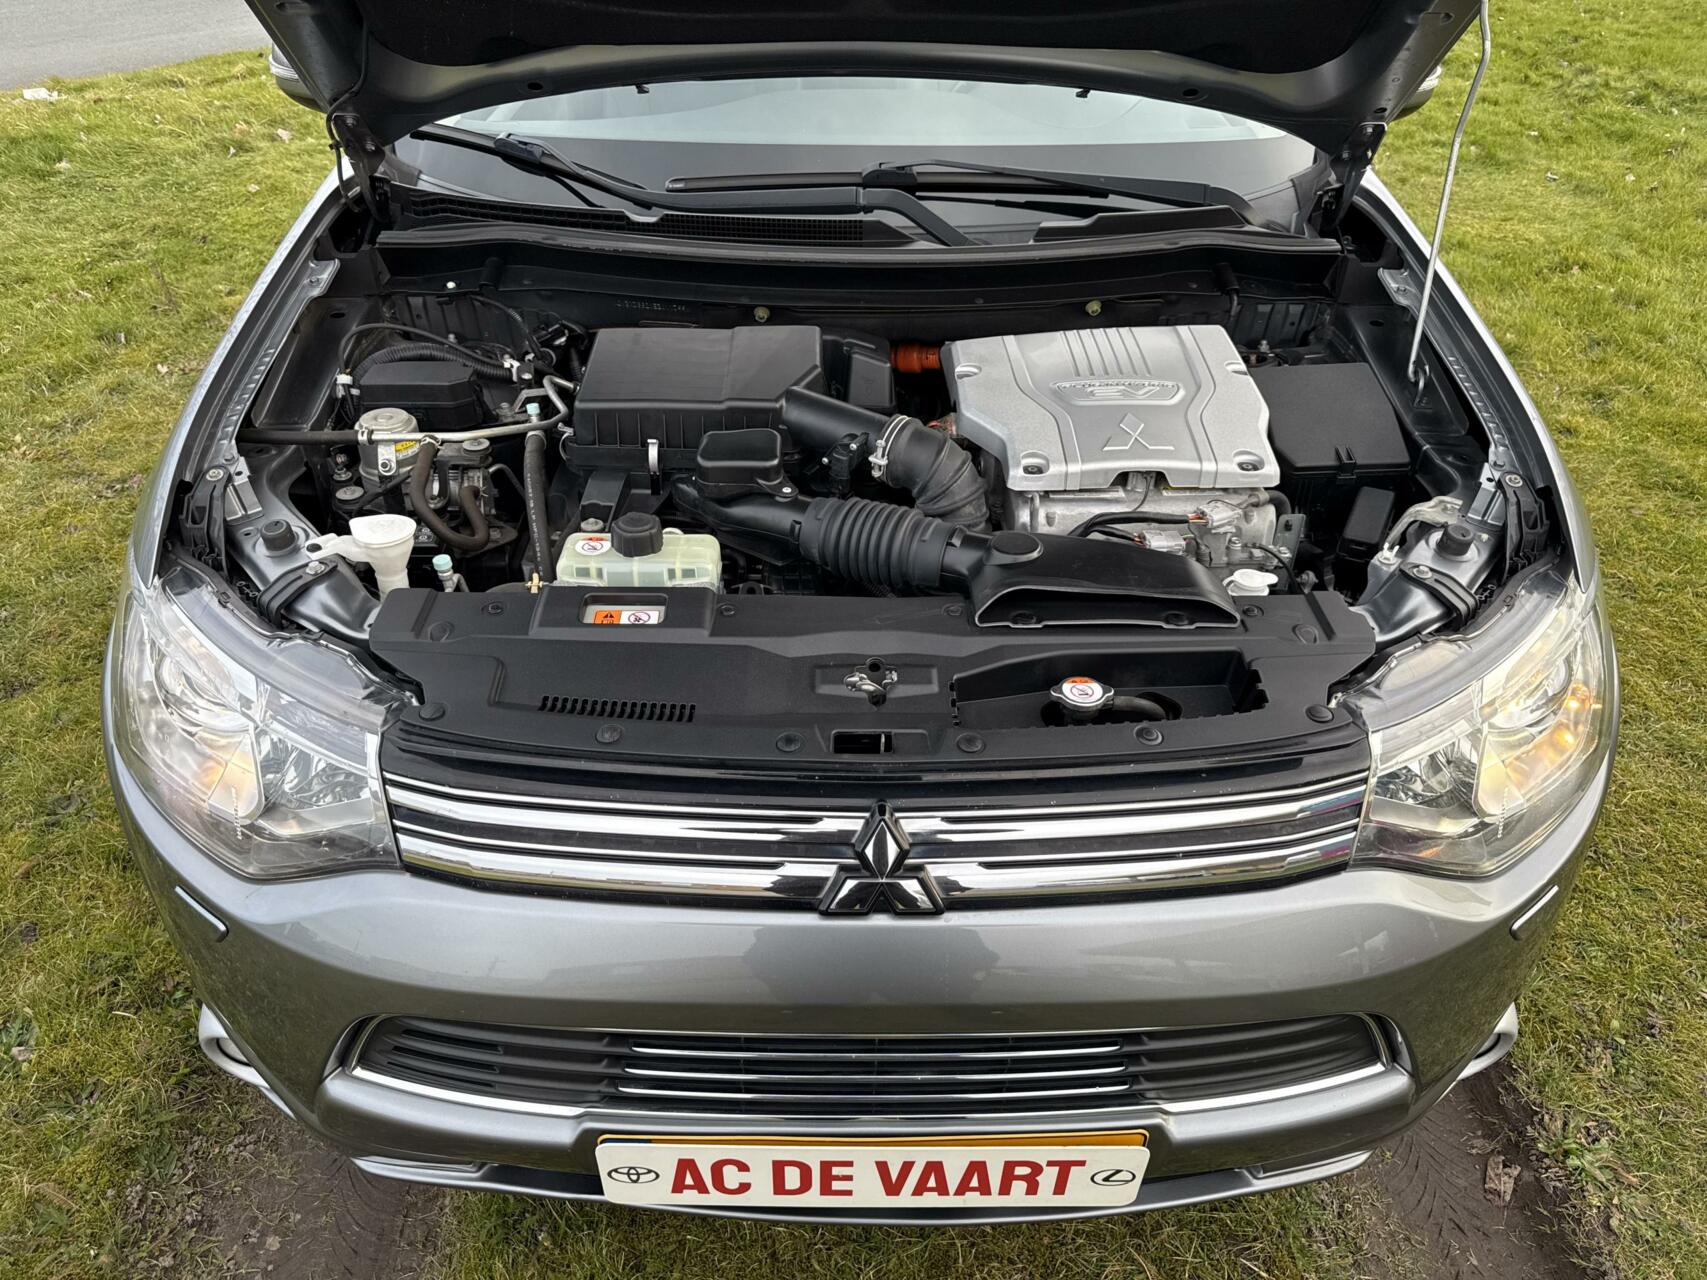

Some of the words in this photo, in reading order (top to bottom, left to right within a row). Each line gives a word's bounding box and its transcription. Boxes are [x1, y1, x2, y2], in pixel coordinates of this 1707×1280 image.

[670, 1157, 752, 1195] AC
[771, 1159, 854, 1196] DE
[874, 1159, 1086, 1197] VAART
